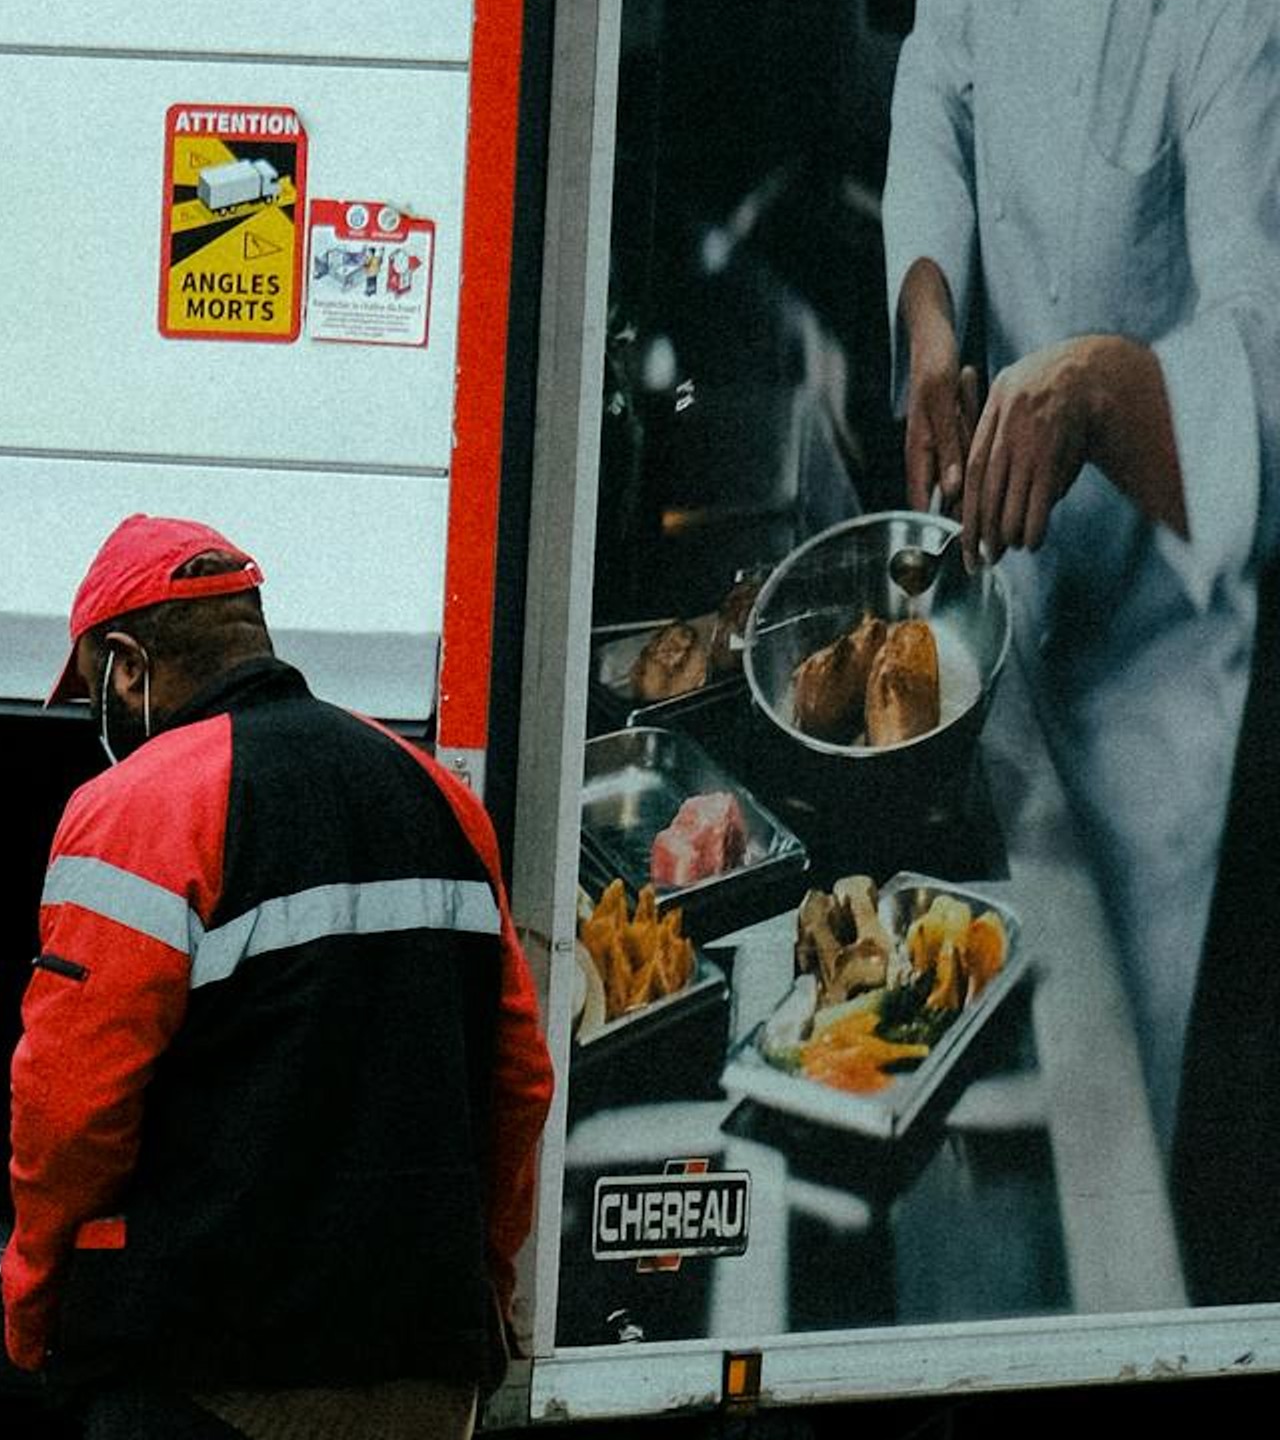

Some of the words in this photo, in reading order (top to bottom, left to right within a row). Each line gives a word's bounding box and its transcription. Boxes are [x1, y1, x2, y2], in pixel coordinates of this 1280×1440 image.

[174, 111, 300, 136] ATTENTION
[181, 272, 281, 295] ANGLES
[185, 298, 275, 321] MORTS
[599, 1189, 744, 1242] CHEREAU
